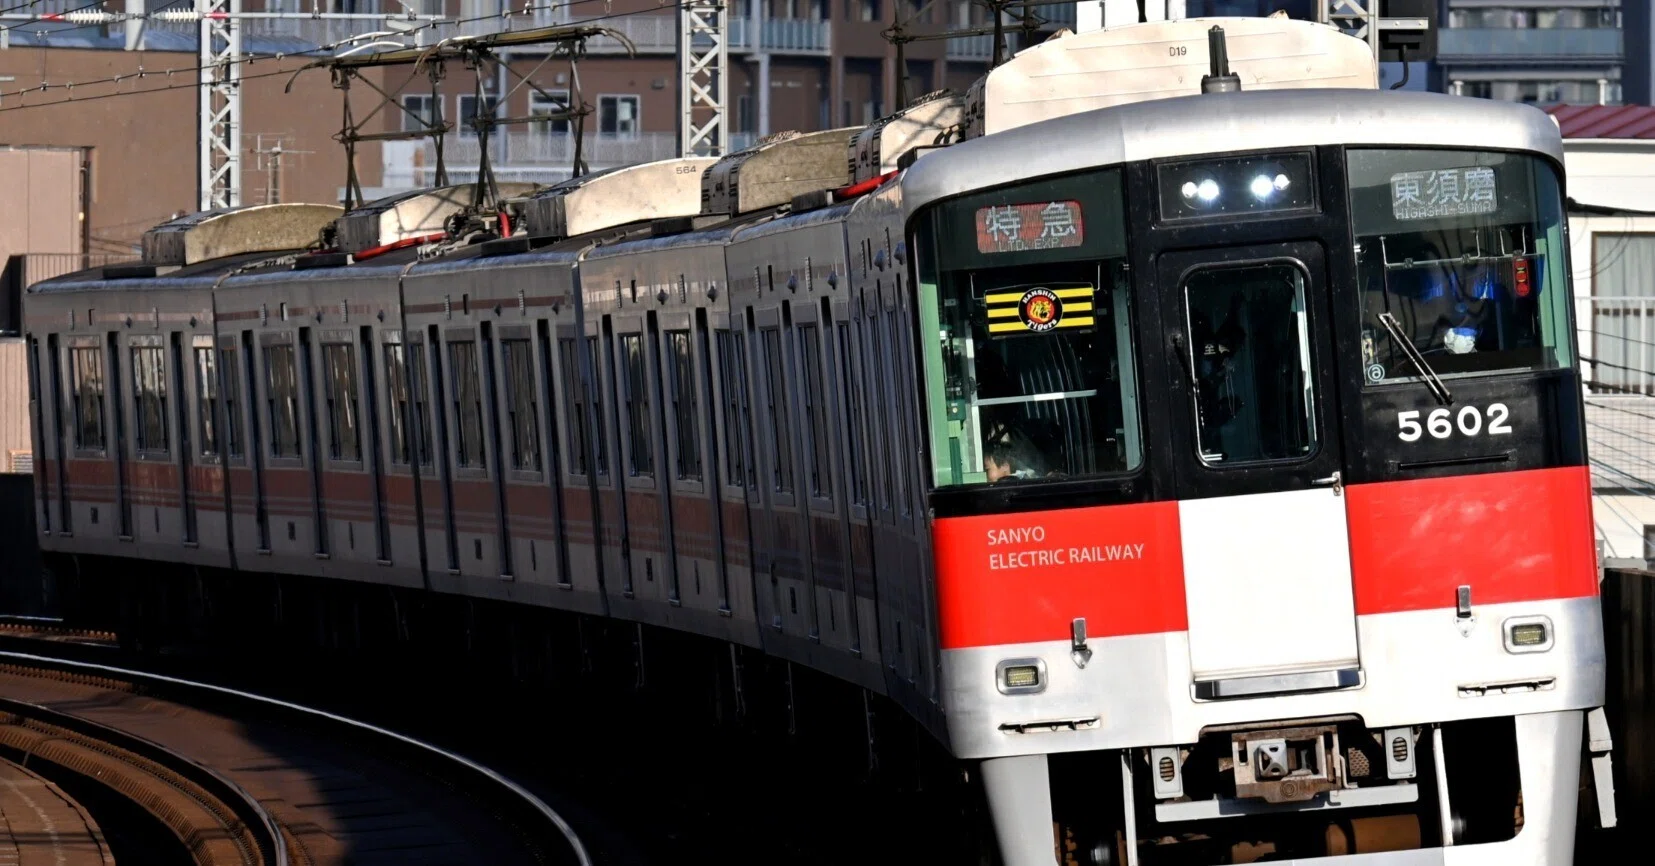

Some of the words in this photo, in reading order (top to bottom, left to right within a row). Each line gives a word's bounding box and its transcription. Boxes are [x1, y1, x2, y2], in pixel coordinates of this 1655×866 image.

[1169, 46, 1187, 57] D19
[675, 165, 697, 174] 564
[1392, 167, 1495, 208] 東須磨
[985, 202, 1076, 242] 特急
[1022, 289, 1056, 304] HANSHIN
[1027, 319, 1057, 331] Tigers
[1397, 402, 1513, 442] 5602
[987, 525, 1046, 546] SANYO
[989, 548, 1066, 570] ELECTRIC
[1069, 543, 1145, 564] RAILWAY
